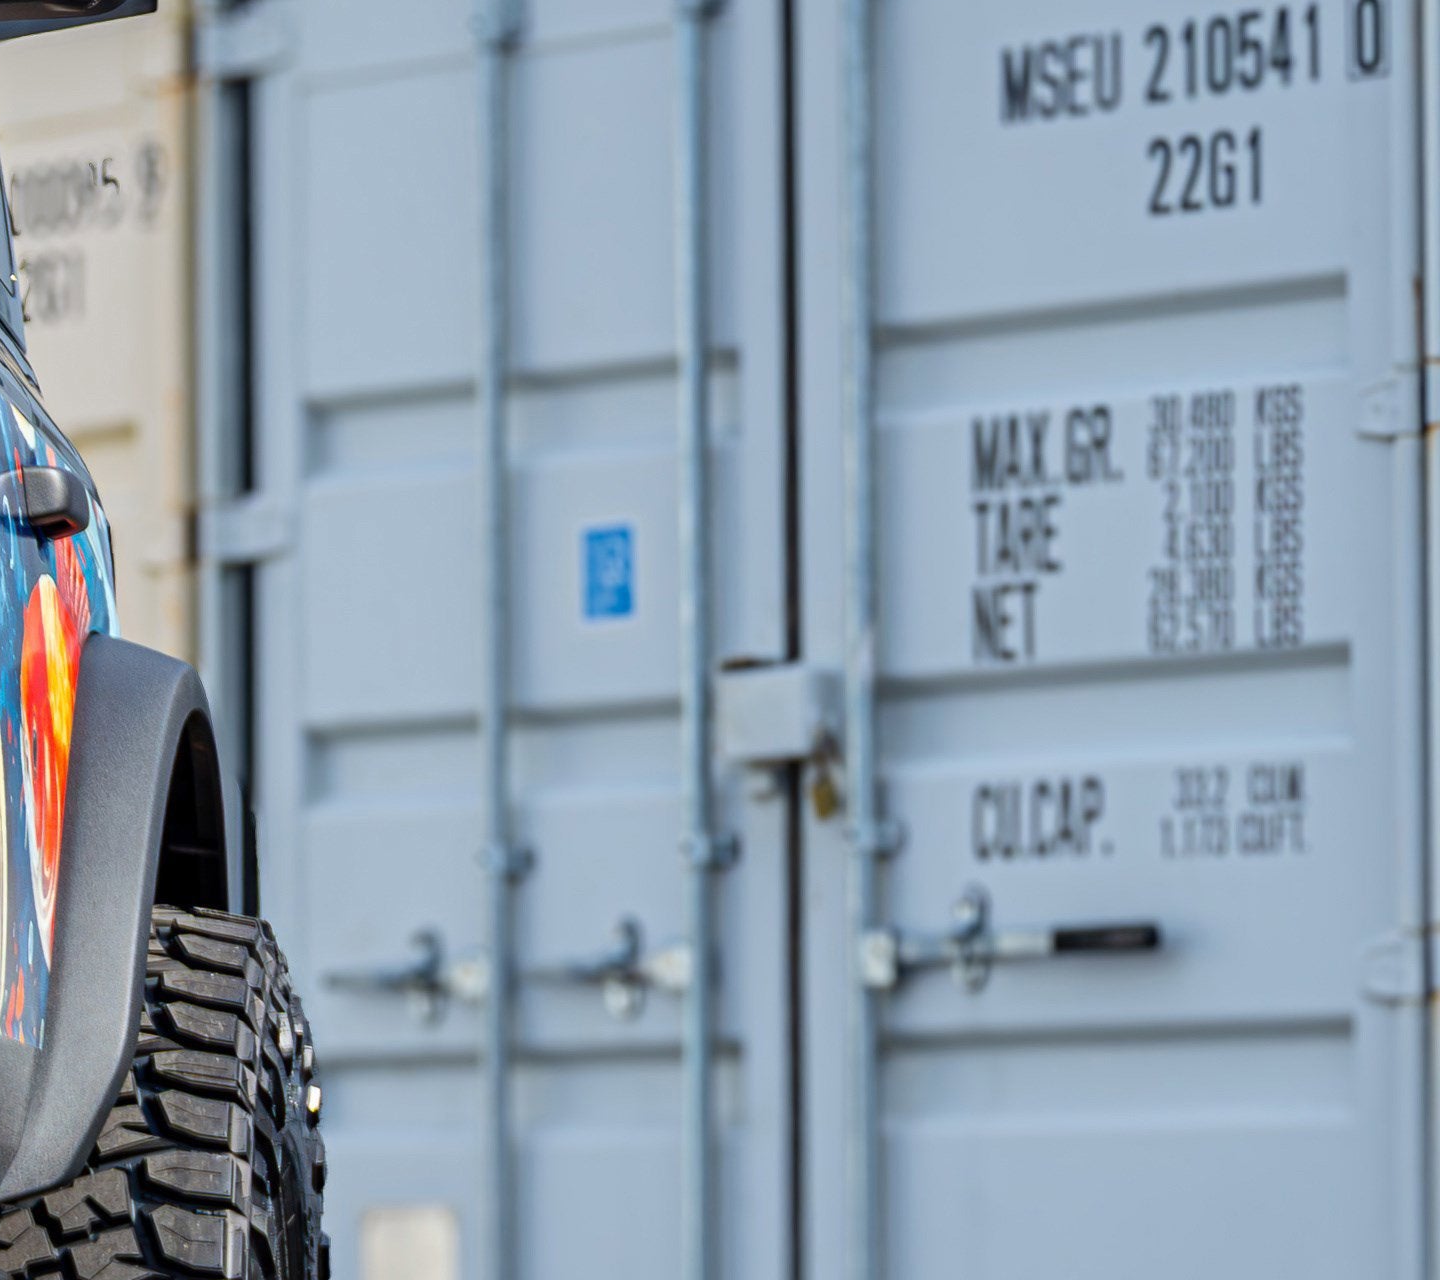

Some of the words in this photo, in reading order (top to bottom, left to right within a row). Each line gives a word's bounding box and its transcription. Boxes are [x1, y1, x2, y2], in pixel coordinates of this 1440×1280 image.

[1001, 32, 1122, 124] MSEU
[1144, 1, 1320, 104] 210541
[1146, 125, 1262, 217] 22G1
[973, 492, 1063, 575] TARE
[972, 581, 1038, 662] NET
